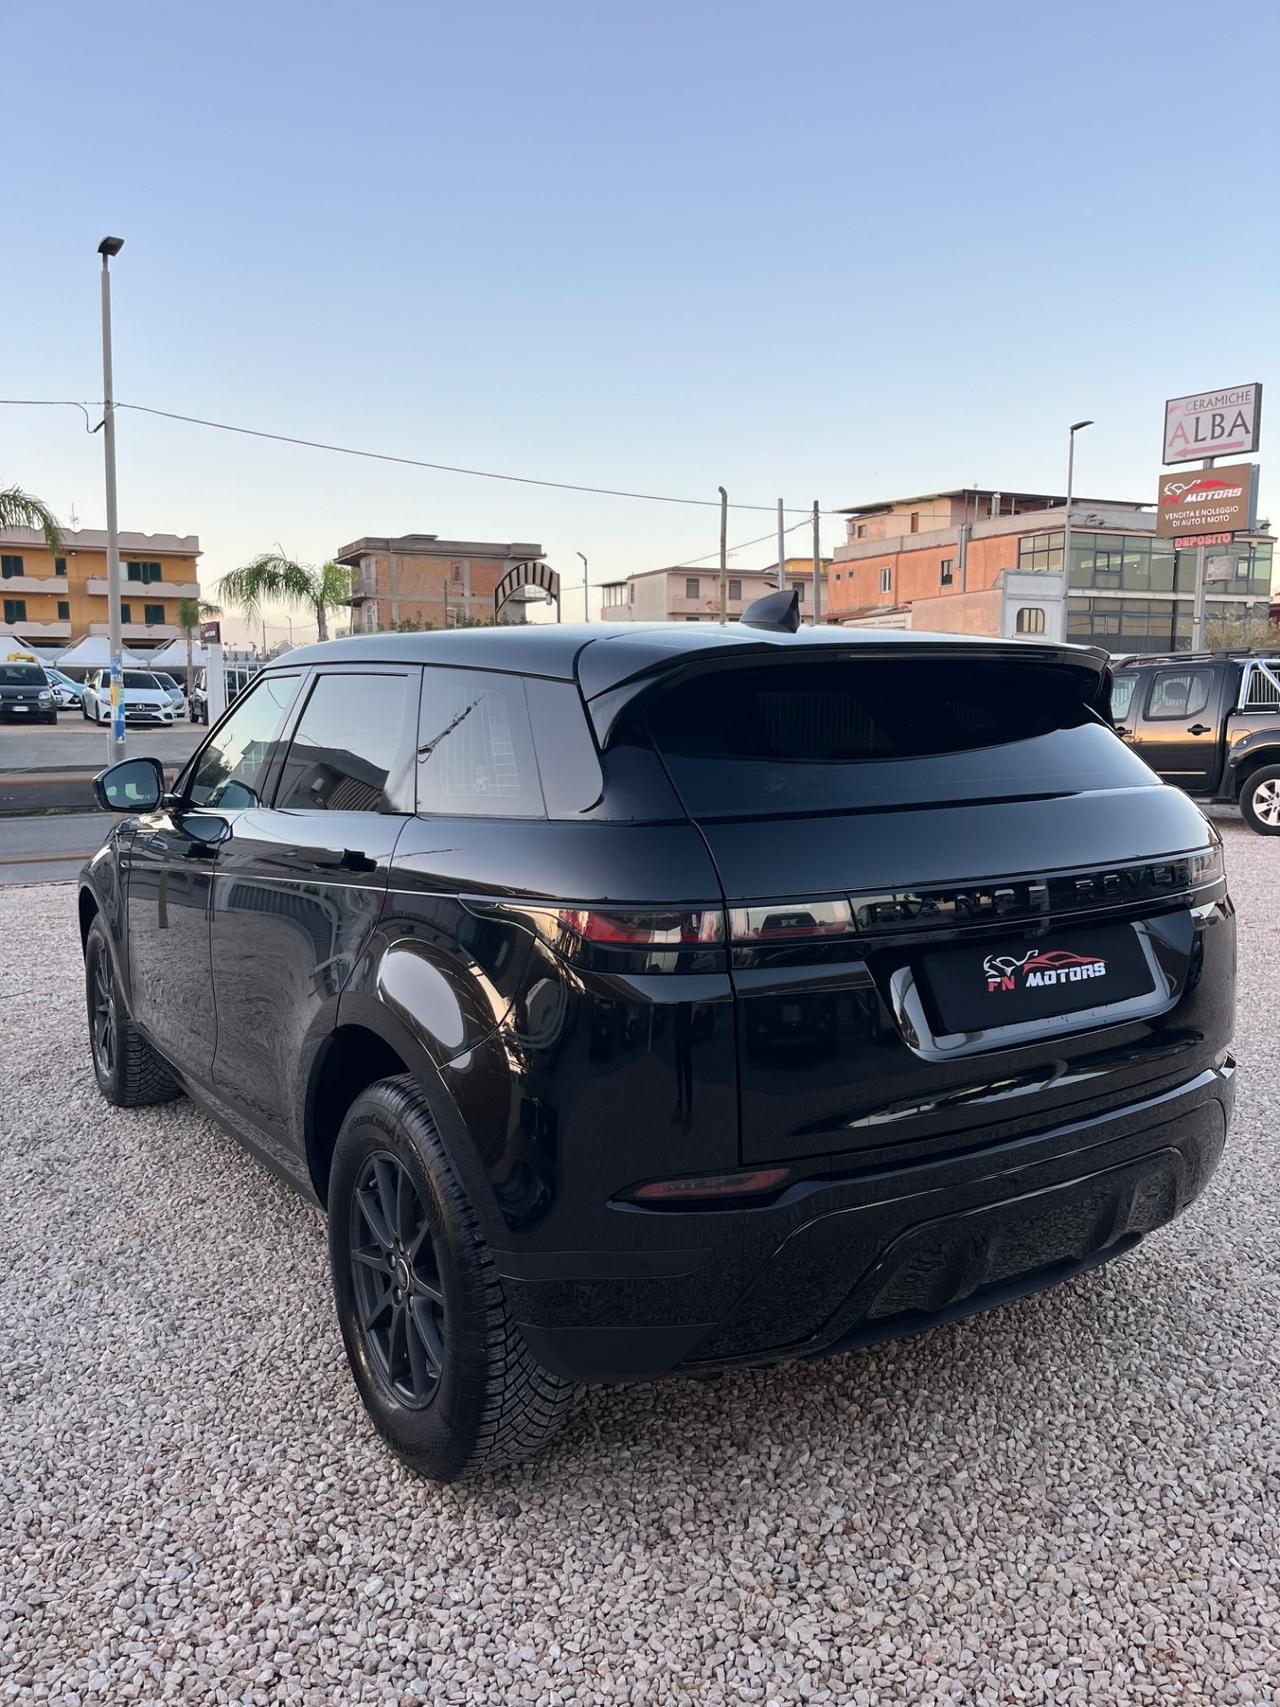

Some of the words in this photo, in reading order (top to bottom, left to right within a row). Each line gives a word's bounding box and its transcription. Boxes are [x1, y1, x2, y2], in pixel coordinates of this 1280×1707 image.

[1185, 390, 1251, 411] CERAMICHE
[1167, 409, 1251, 448] ALBA
[1184, 487, 1243, 503] MOTORS
[1165, 510, 1194, 520] VENDITA
[1201, 505, 1239, 516] NOLEGGIO
[1172, 520, 1181, 528] DI
[1181, 518, 1201, 526] AUTO
[1207, 514, 1230, 523] MOTO
[1174, 533, 1231, 548] DEPOSITO
[987, 975, 1016, 992] FN
[1025, 962, 1107, 988] MOTORS
